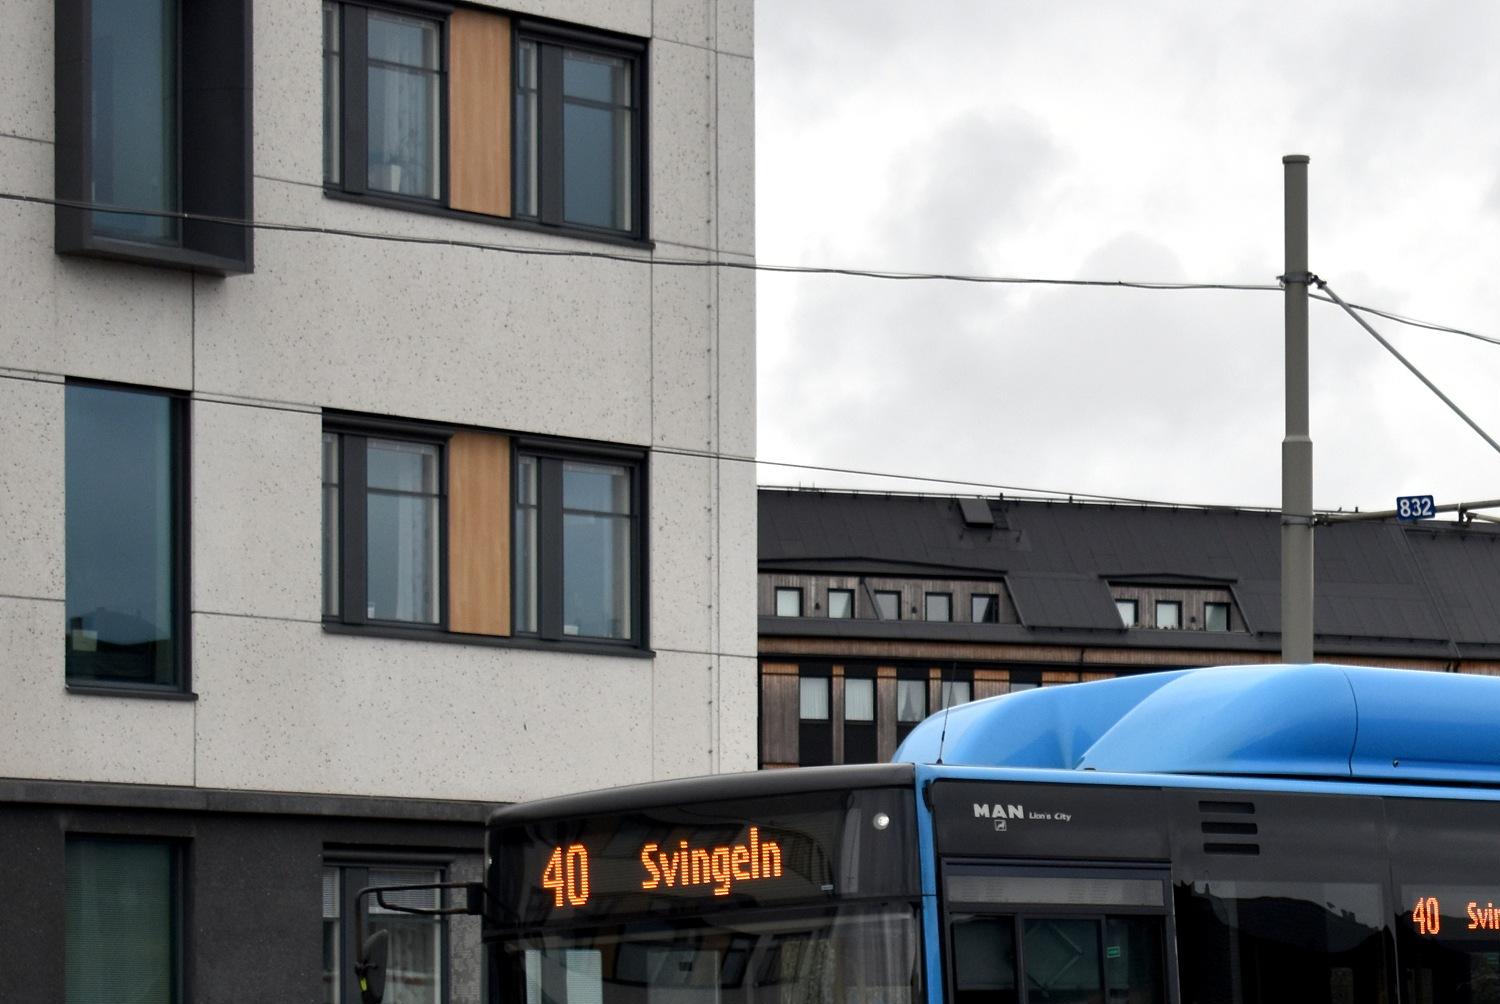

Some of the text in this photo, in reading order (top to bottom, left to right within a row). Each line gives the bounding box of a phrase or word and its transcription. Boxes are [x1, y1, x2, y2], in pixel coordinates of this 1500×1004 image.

[1400, 498, 1432, 518] 832
[973, 803, 1025, 819] MAN
[1054, 812, 1072, 822] City
[542, 826, 782, 908] 40 Svingeln
[1412, 897, 1440, 935] 40
